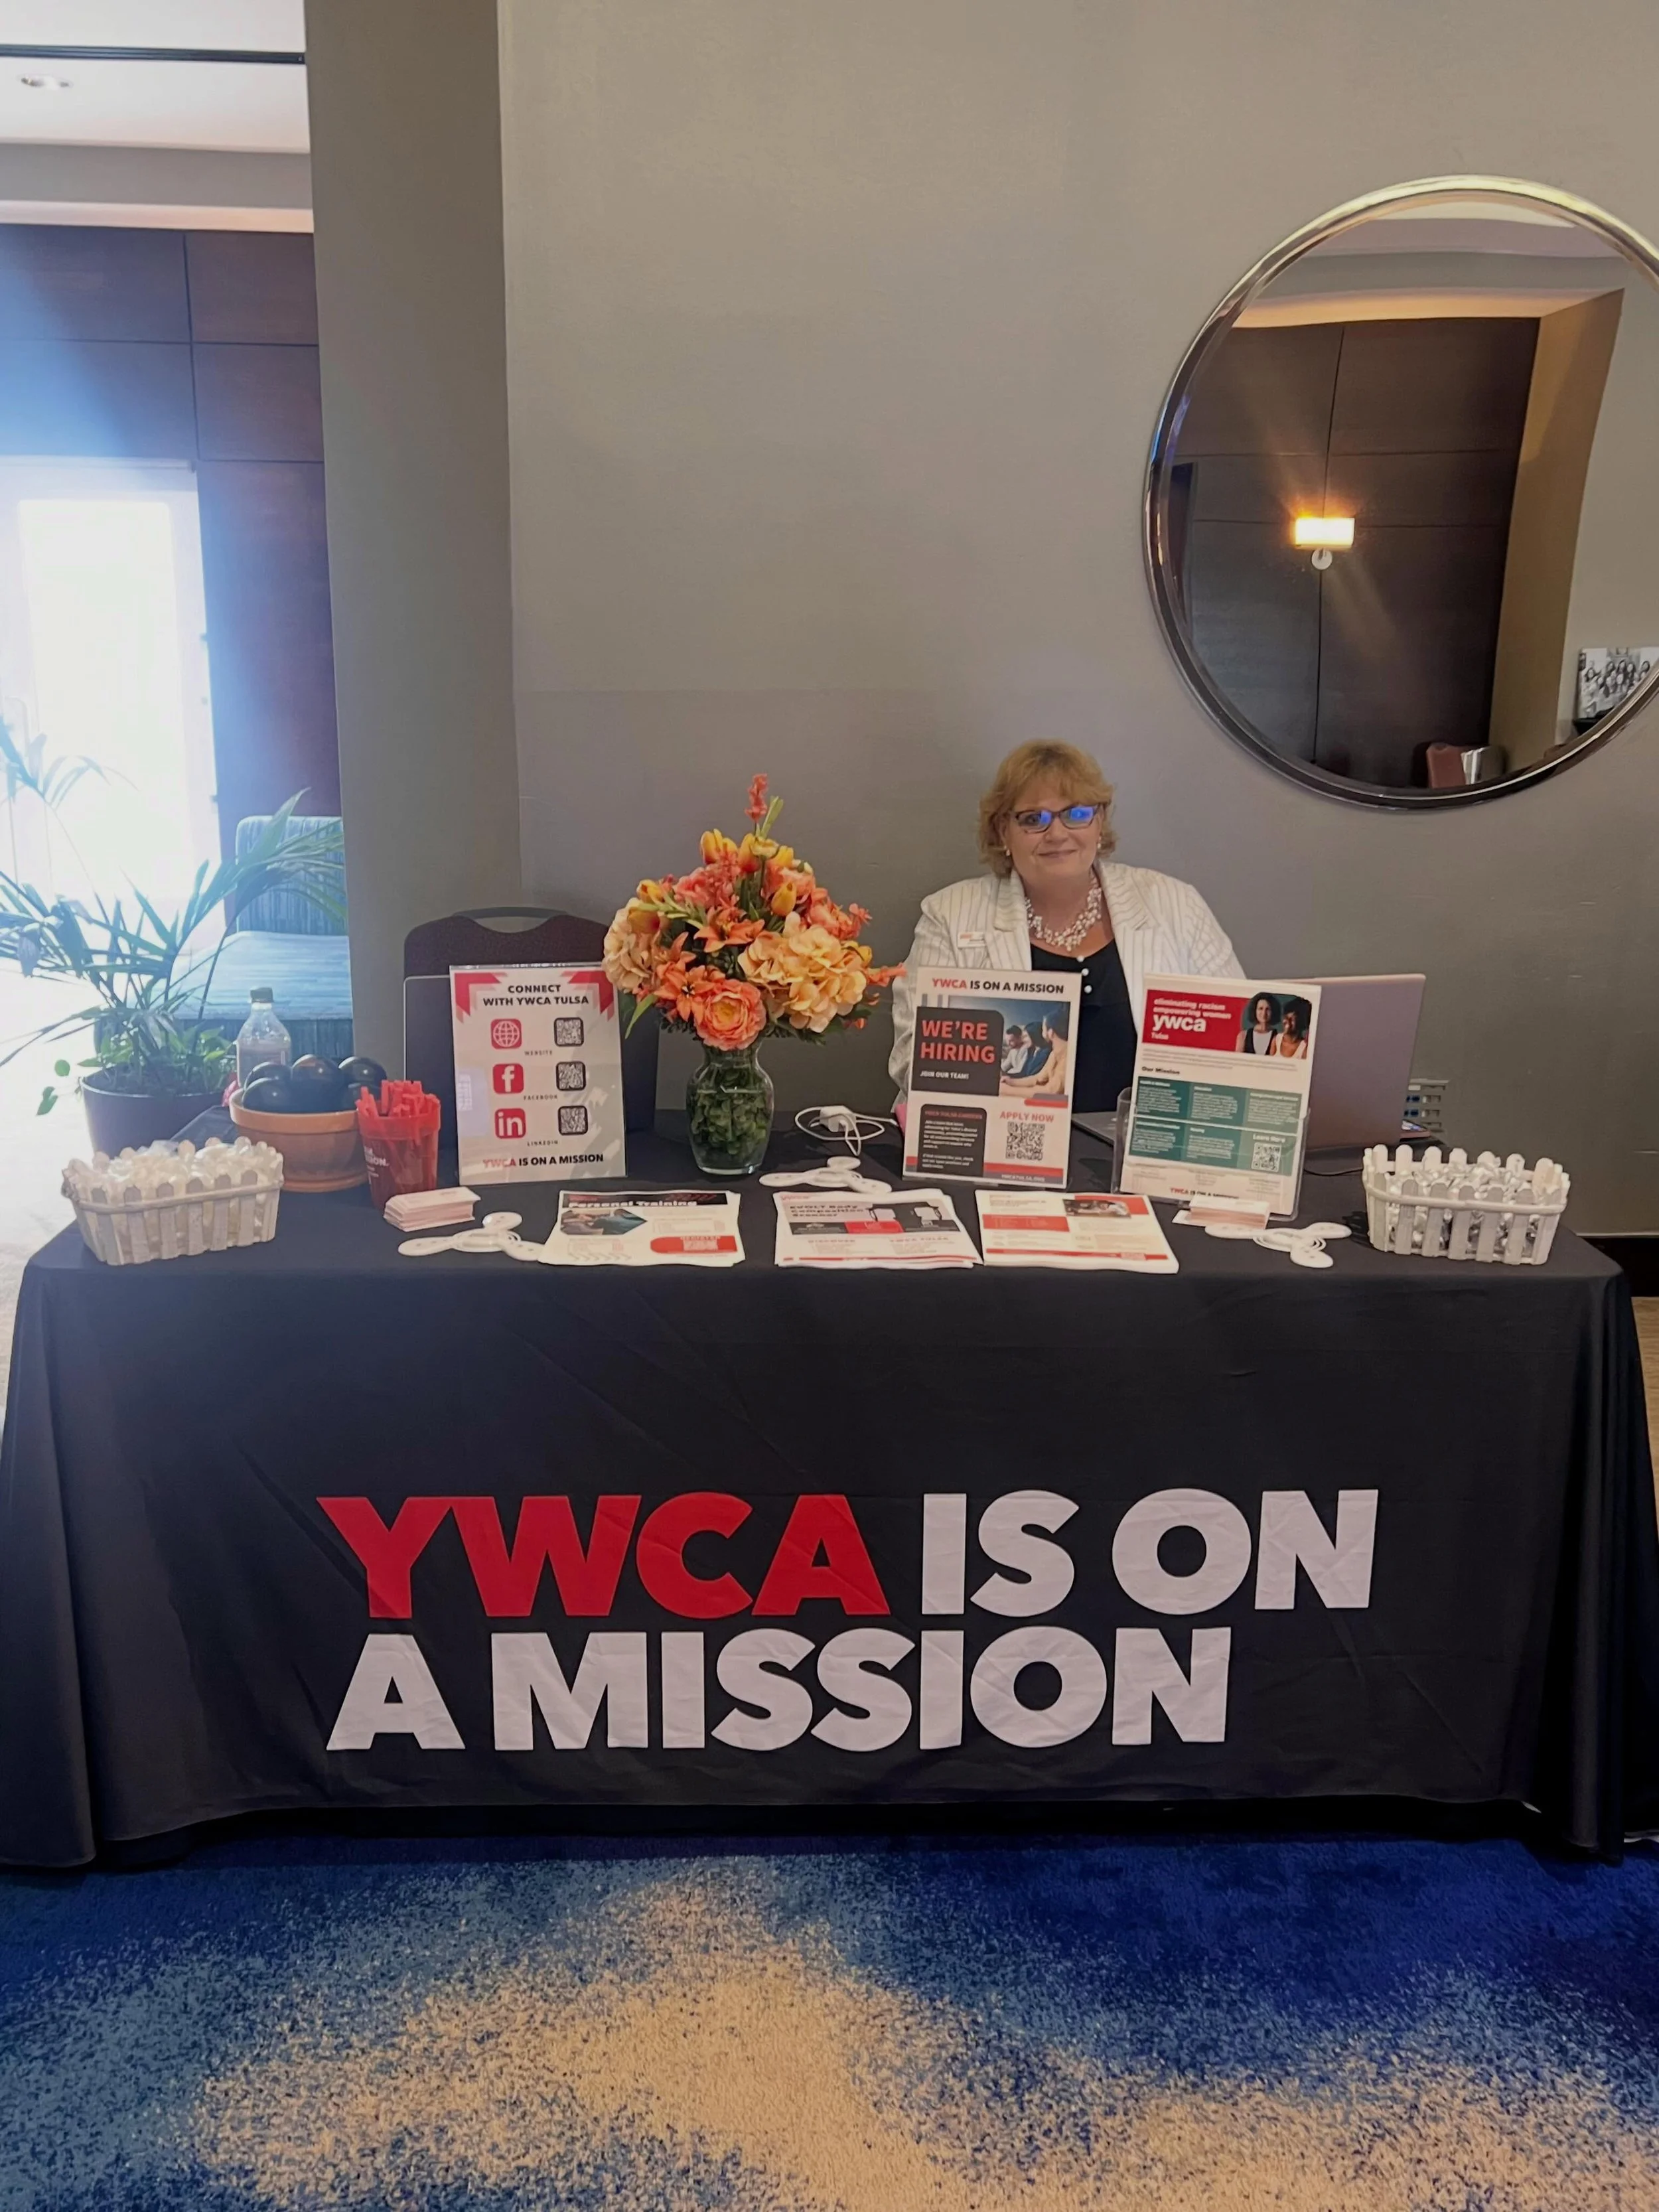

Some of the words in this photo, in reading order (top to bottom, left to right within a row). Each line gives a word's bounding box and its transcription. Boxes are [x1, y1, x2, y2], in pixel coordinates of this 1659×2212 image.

[508, 984, 561, 994] CONNECT
[932, 978, 967, 989] YWCA
[970, 980, 980, 990] IS
[983, 981, 1000, 991] ON
[1002, 982, 1011, 991] A
[1014, 982, 1064, 994] MISSION
[483, 997, 513, 1006] WITH
[516, 996, 551, 1005] YWCA
[554, 995, 589, 1004] TULSA
[922, 1020, 988, 1041] WE'RE
[1152, 1014, 1206, 1033] ywca
[920, 1042, 995, 1063] HIRING
[999, 1111, 1029, 1121] APPLY
[1031, 1113, 1054, 1122] NOW
[483, 1158, 516, 1167] YWCA
[519, 1157, 529, 1166] IS
[531, 1157, 547, 1165] ON
[549, 1156, 559, 1165] A
[559, 1153, 603, 1164] MISSION
[316, 1491, 891, 1619] YWCA
[922, 1489, 1080, 1617] IS
[1112, 1488, 1379, 1615] ON
[326, 1633, 466, 1751] A
[490, 1625, 1232, 1752] MISSION
